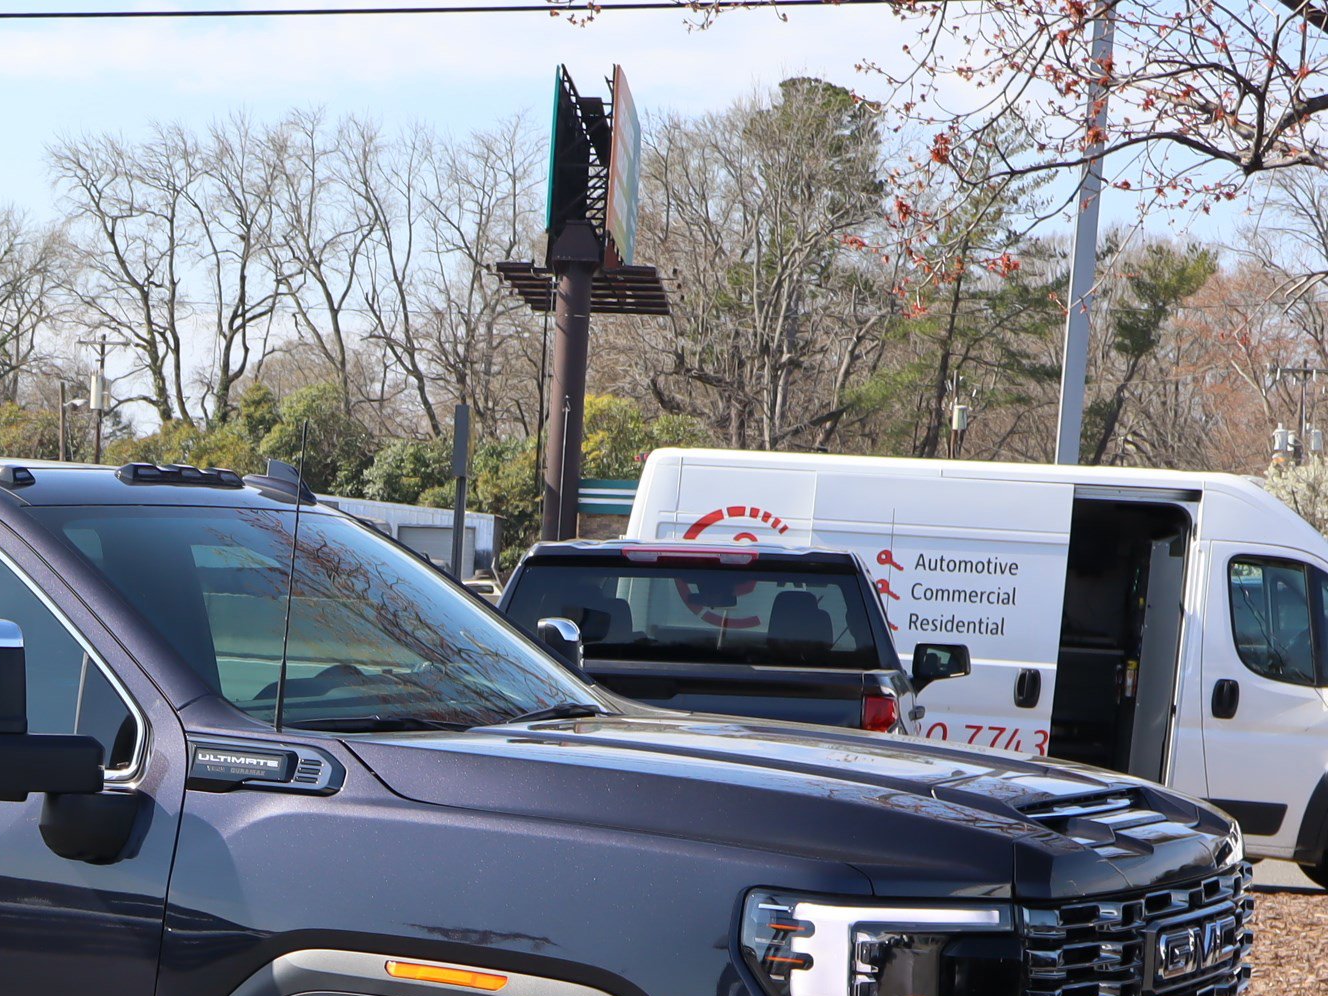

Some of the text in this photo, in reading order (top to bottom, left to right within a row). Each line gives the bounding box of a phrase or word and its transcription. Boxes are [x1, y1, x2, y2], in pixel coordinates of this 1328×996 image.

[914, 552, 1019, 576] Automotive
[910, 582, 1016, 606] Commercial
[908, 612, 1005, 637] Residential
[198, 753, 279, 768] ULTIMATE
[1158, 914, 1237, 981] GMC
